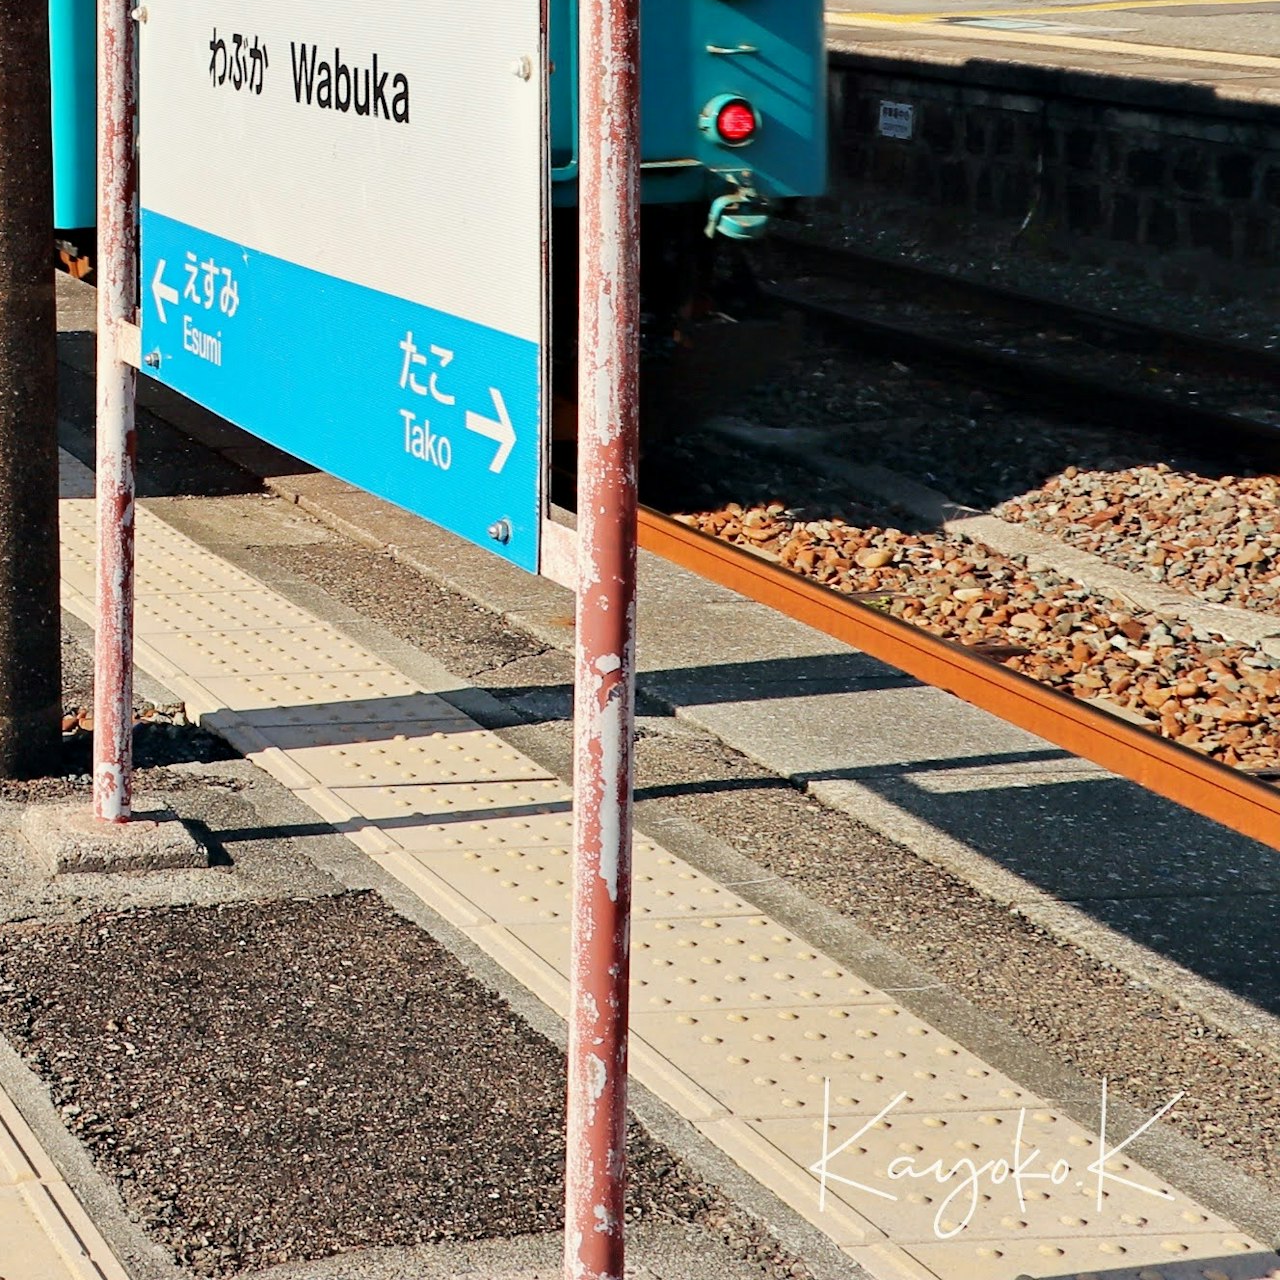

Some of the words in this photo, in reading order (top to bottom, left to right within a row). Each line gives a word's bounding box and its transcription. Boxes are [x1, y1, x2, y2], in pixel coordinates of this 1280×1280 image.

[209, 27, 269, 95] わぶか
[290, 41, 410, 124] Wabuka
[183, 251, 239, 318] えすみ
[183, 315, 222, 367] Esumi
[399, 330, 456, 406] たこ
[400, 408, 452, 471] Tako
